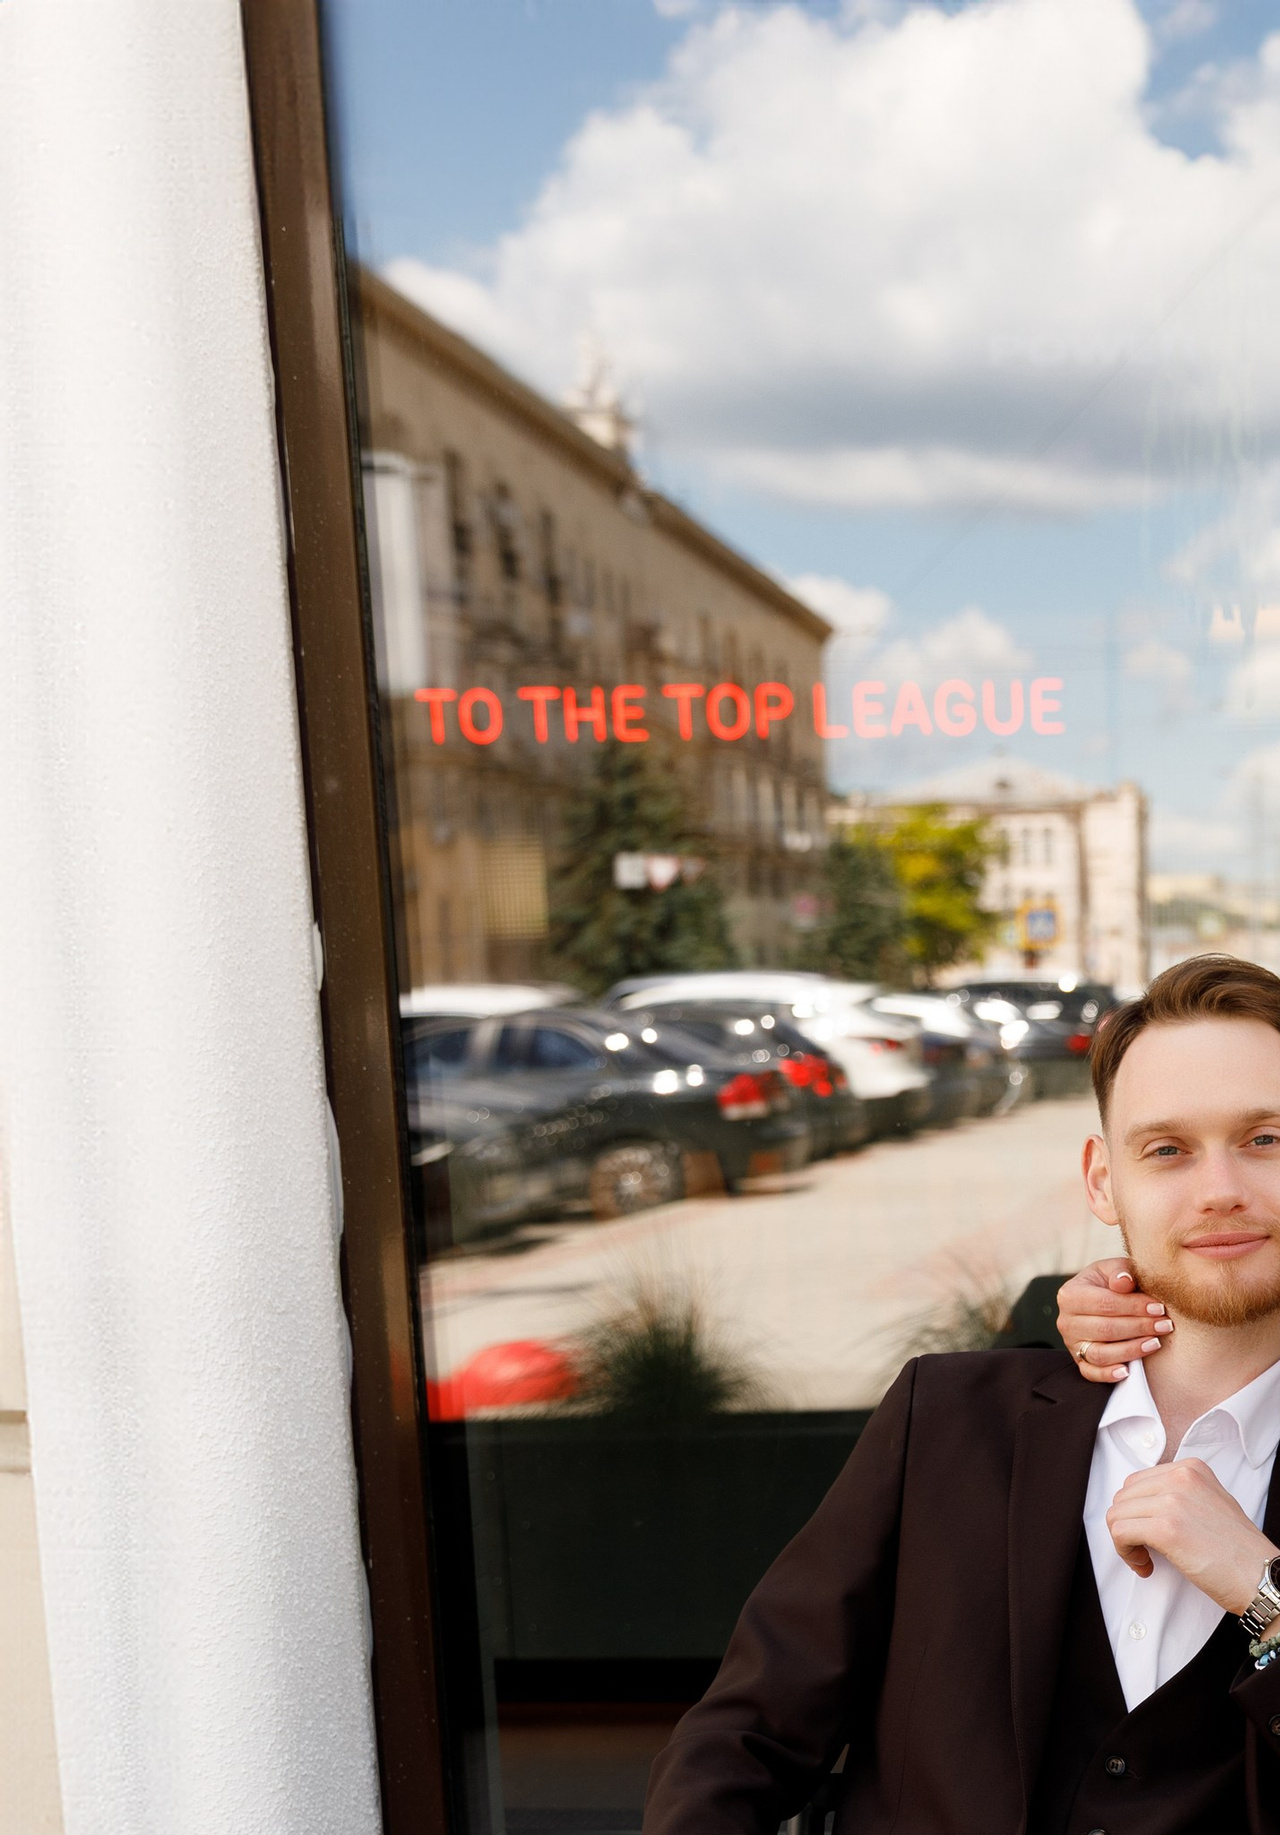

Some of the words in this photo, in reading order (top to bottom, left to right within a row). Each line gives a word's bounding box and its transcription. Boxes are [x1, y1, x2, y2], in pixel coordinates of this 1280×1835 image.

[413, 685, 505, 746] TO
[516, 684, 651, 744] THE
[661, 681, 796, 742] TOP
[812, 677, 1066, 739] LEAGUE
